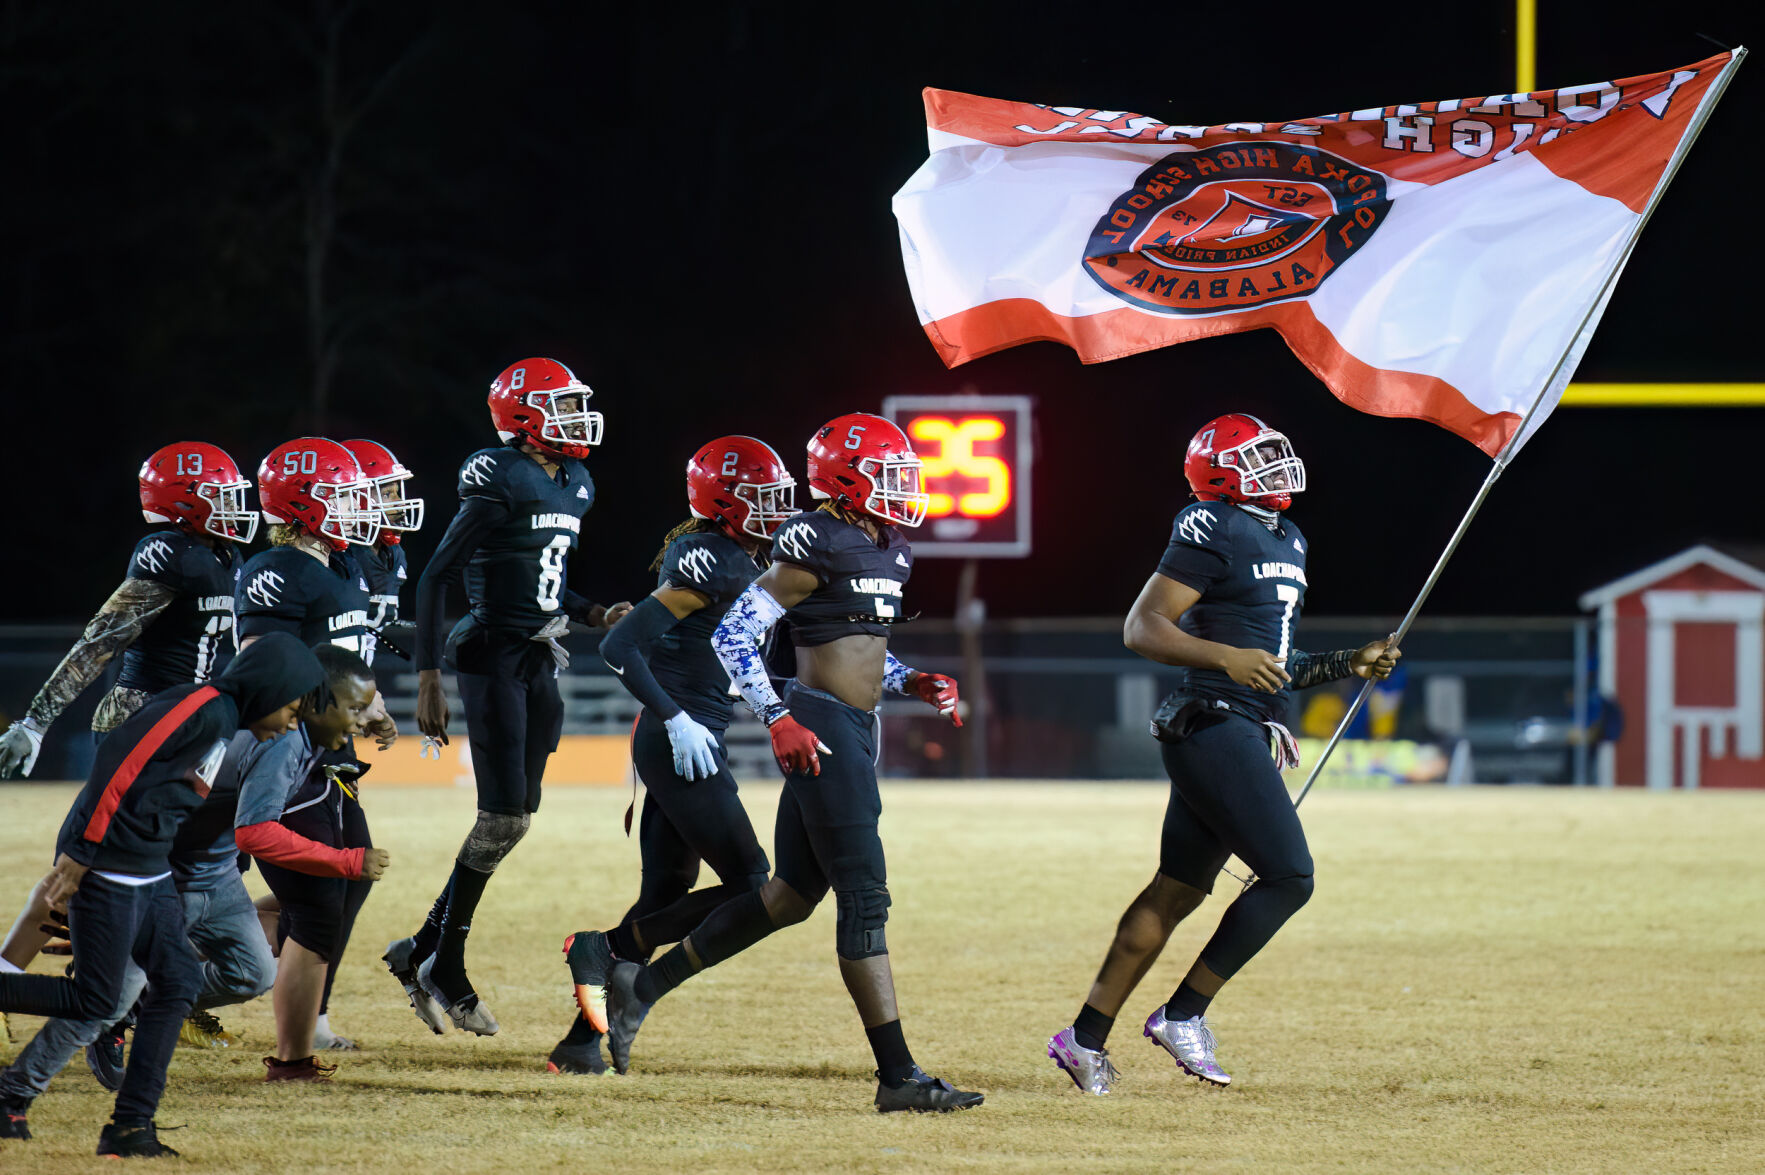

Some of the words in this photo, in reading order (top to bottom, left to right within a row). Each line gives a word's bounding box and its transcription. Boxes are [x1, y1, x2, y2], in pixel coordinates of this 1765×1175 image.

[510, 367, 527, 390] 8
[844, 425, 867, 450] 5
[1199, 428, 1216, 455] 7
[175, 453, 203, 476] 13
[283, 450, 318, 476] 50
[721, 451, 740, 477] 2
[906, 414, 1013, 519] 25
[536, 534, 571, 612] 8
[1275, 583, 1299, 670] 7
